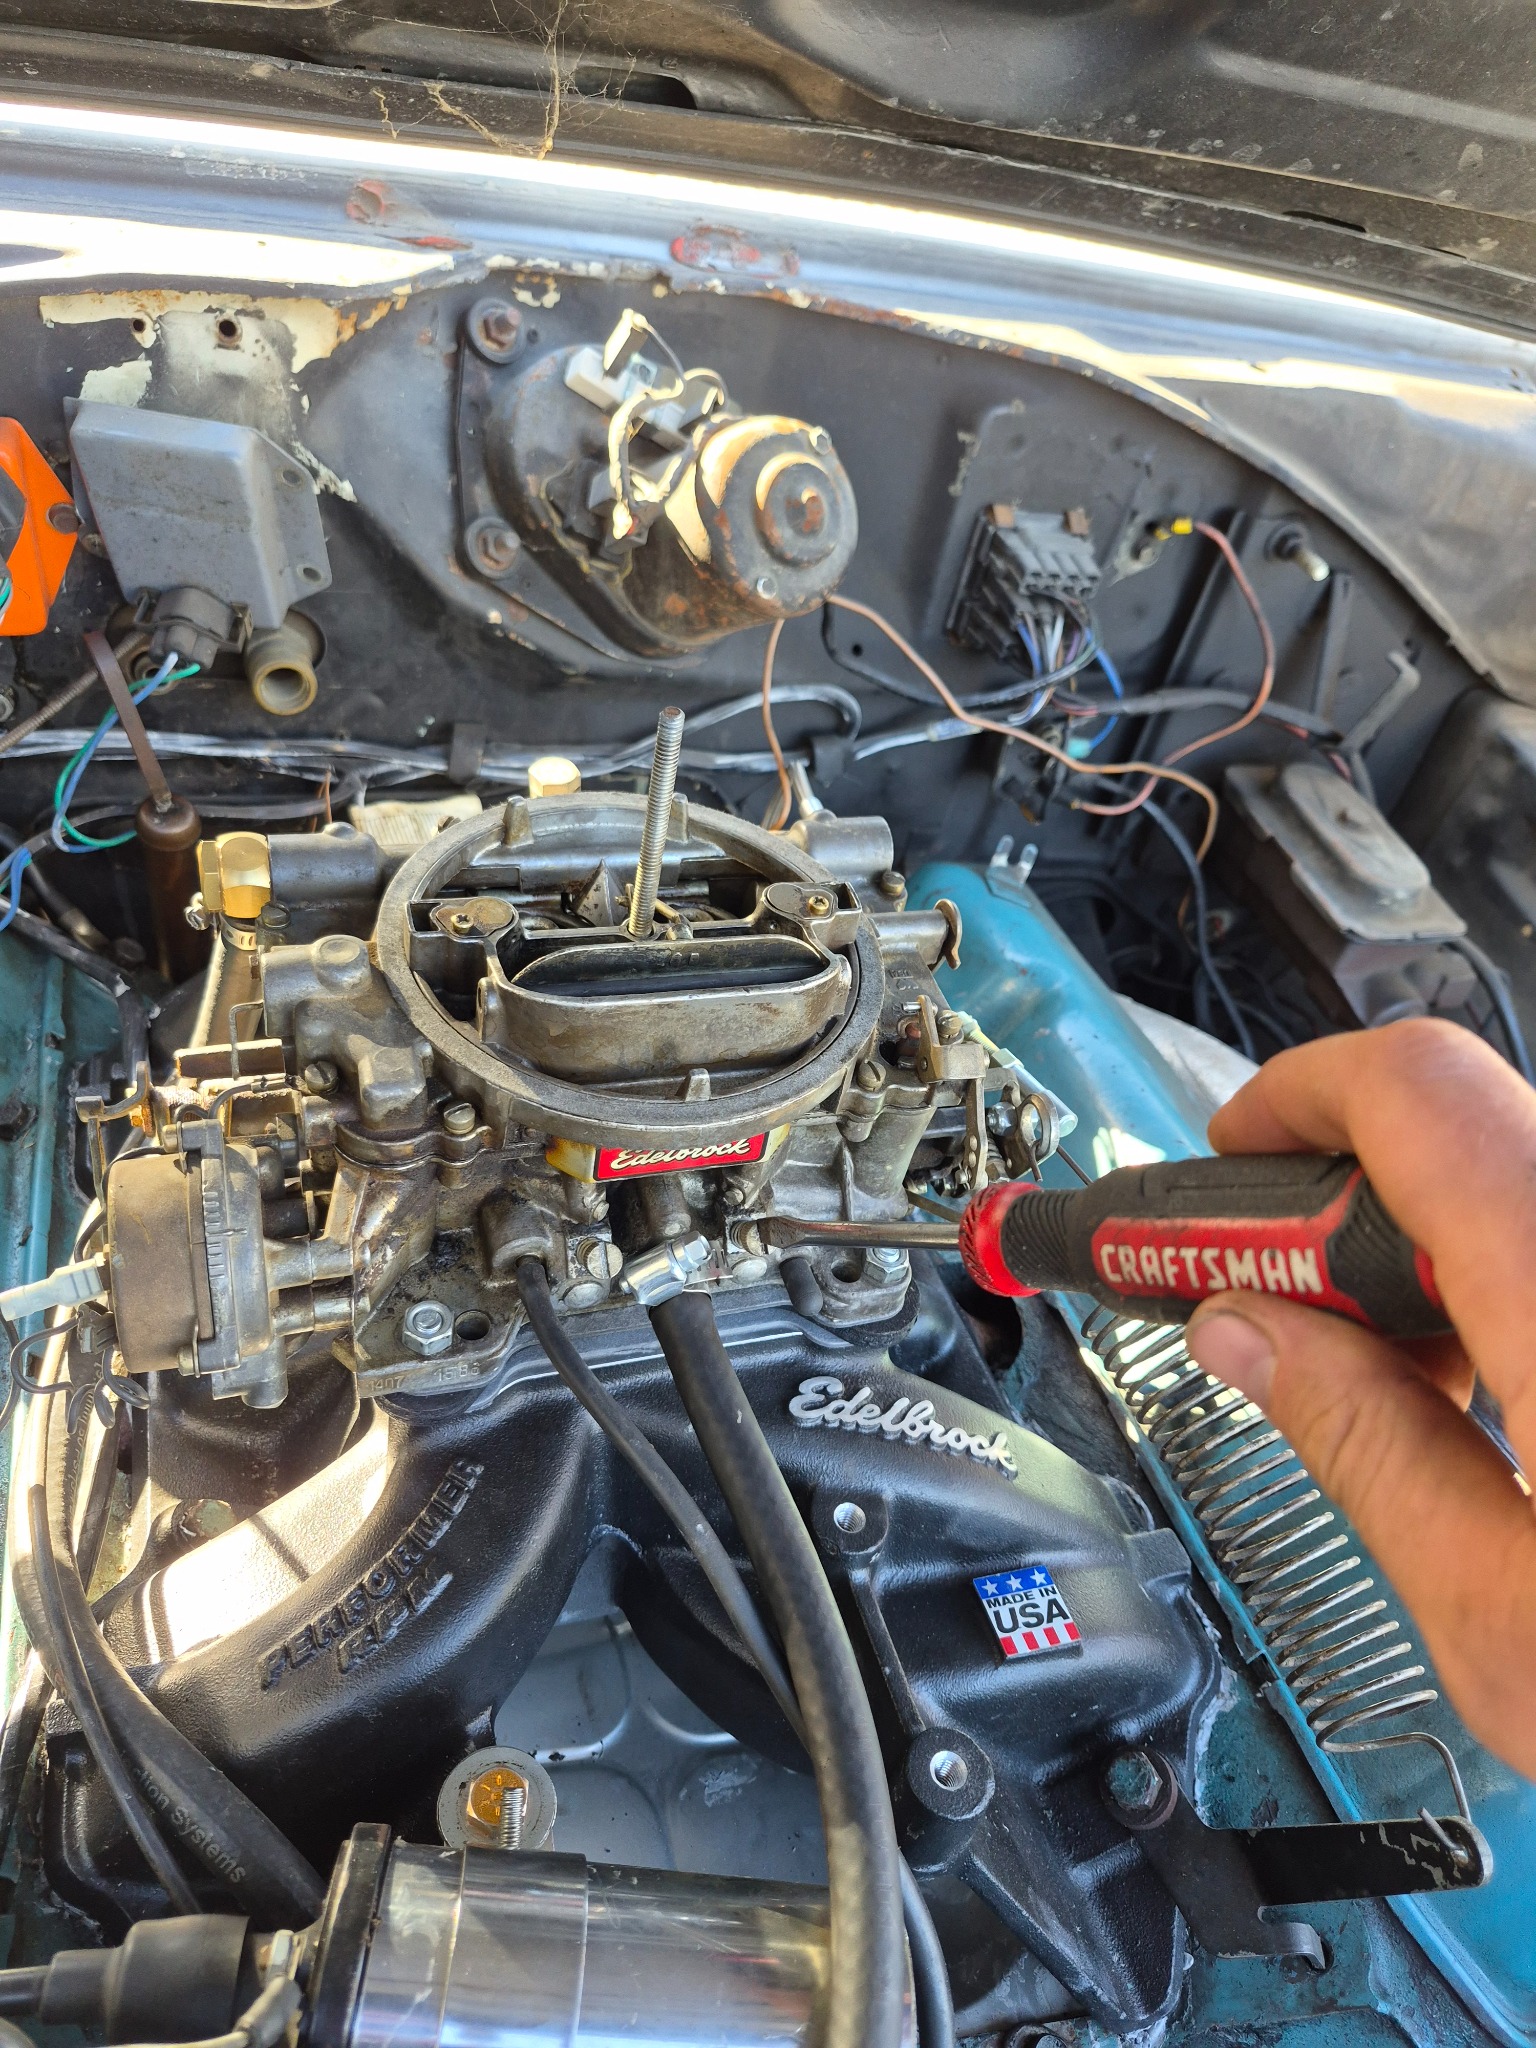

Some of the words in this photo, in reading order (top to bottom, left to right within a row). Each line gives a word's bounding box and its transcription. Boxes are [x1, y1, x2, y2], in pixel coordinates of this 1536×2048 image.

[1100, 1243, 1324, 1294] CRAFTSMAN
[788, 1375, 1019, 1477] Edelbrock
[261, 1458, 485, 1691] PERFORMER
[985, 1590, 1036, 1609] MADE
[1038, 1585, 1058, 1598] IN
[992, 1597, 1070, 1634] USA
[170, 1806, 246, 1884] Systems
